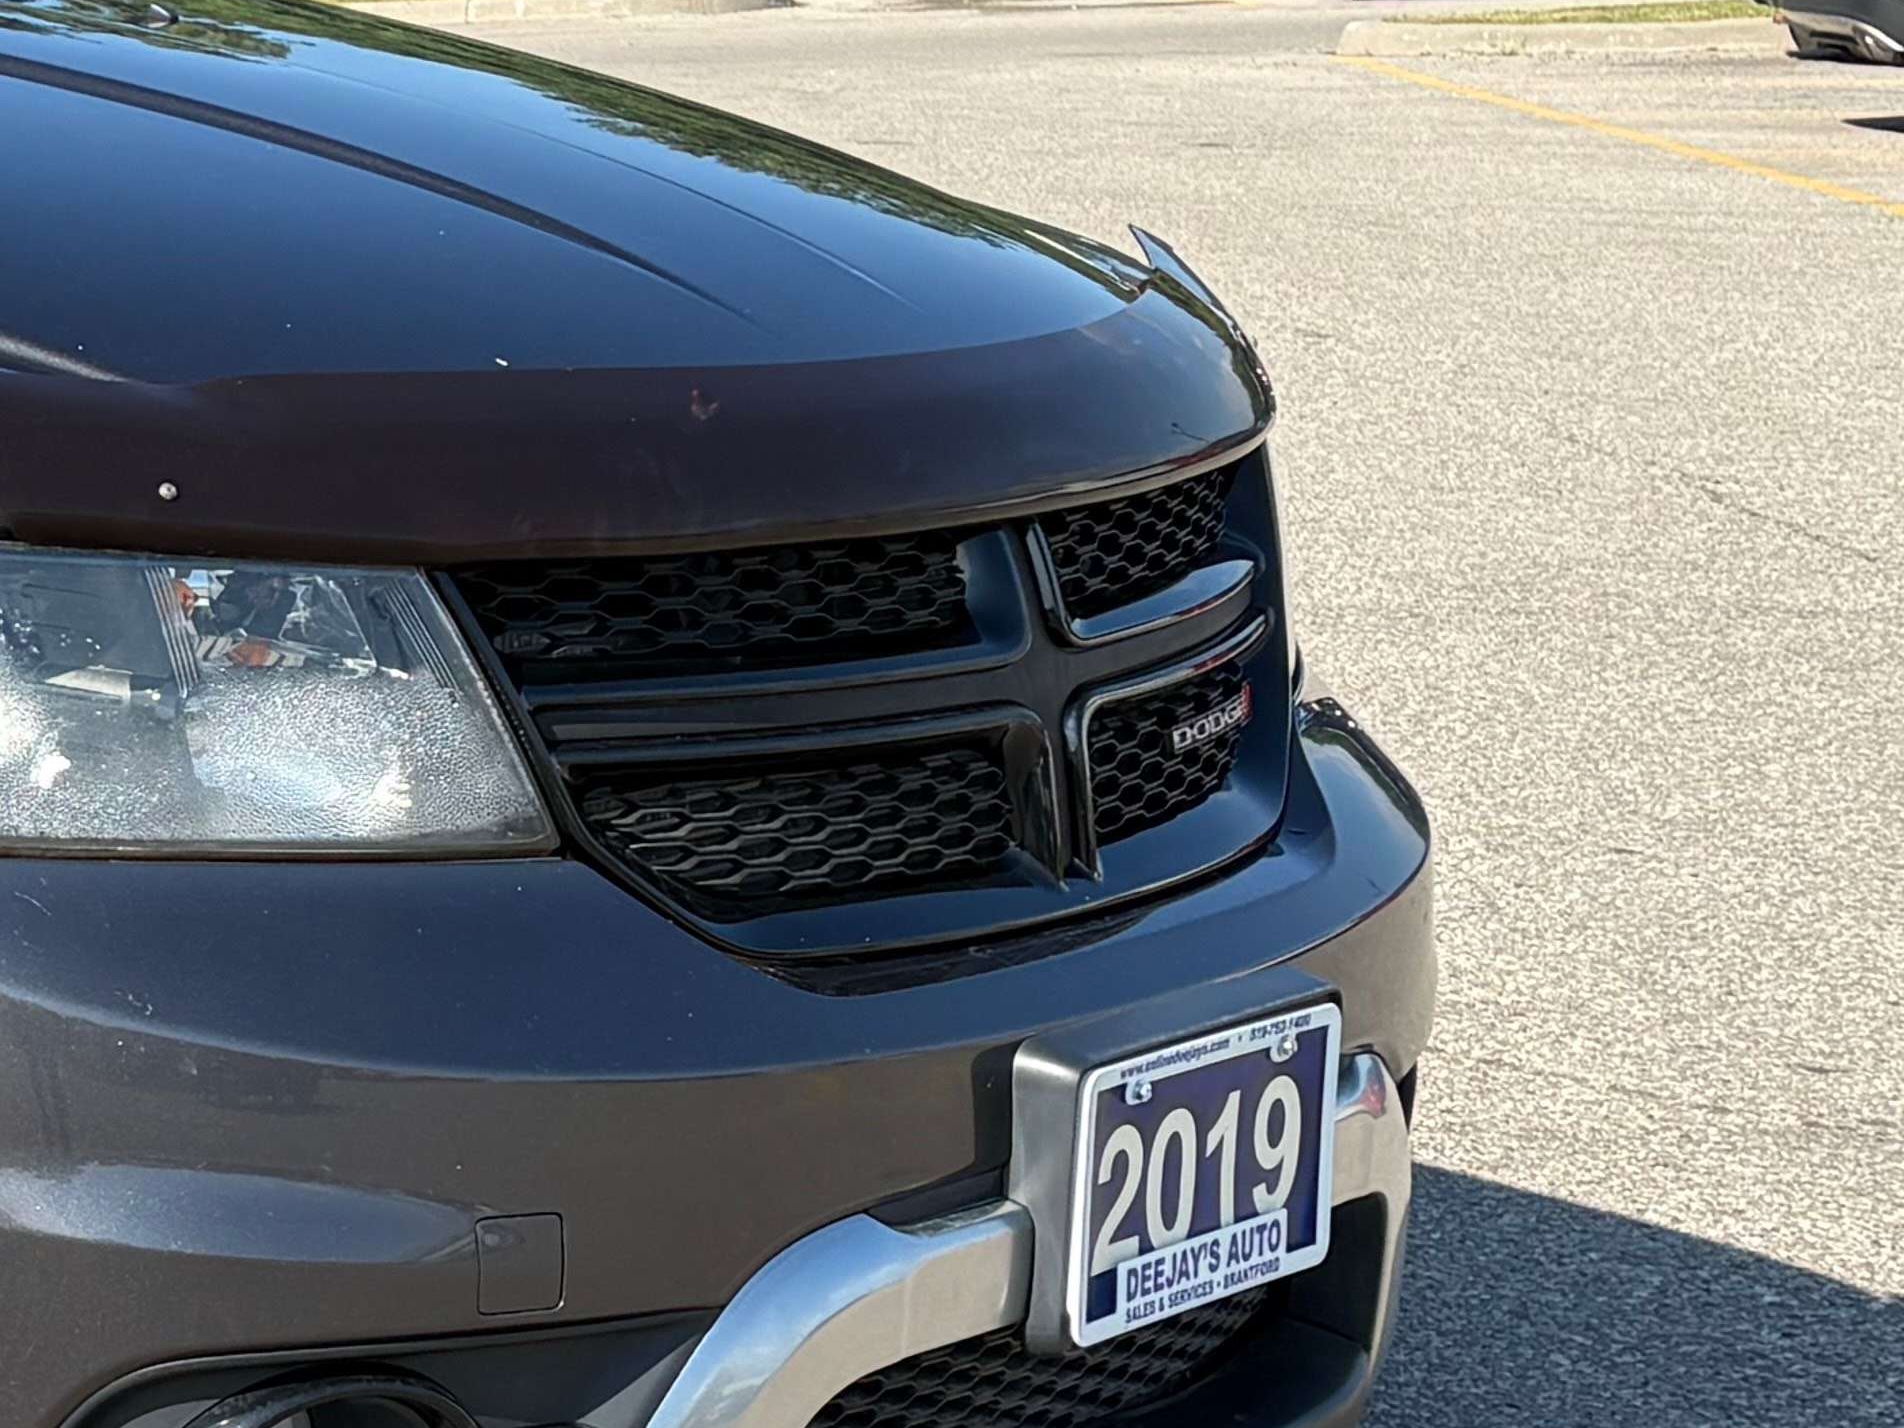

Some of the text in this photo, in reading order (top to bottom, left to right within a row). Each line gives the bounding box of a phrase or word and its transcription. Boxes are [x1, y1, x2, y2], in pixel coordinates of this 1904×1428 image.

[1091, 1075, 1302, 1277] 2019
[1125, 1299, 1156, 1324] SALES
[1223, 1257, 1281, 1290] BRANTFORD
[1126, 1219, 1281, 1304] DEEJAY'S AUTO
